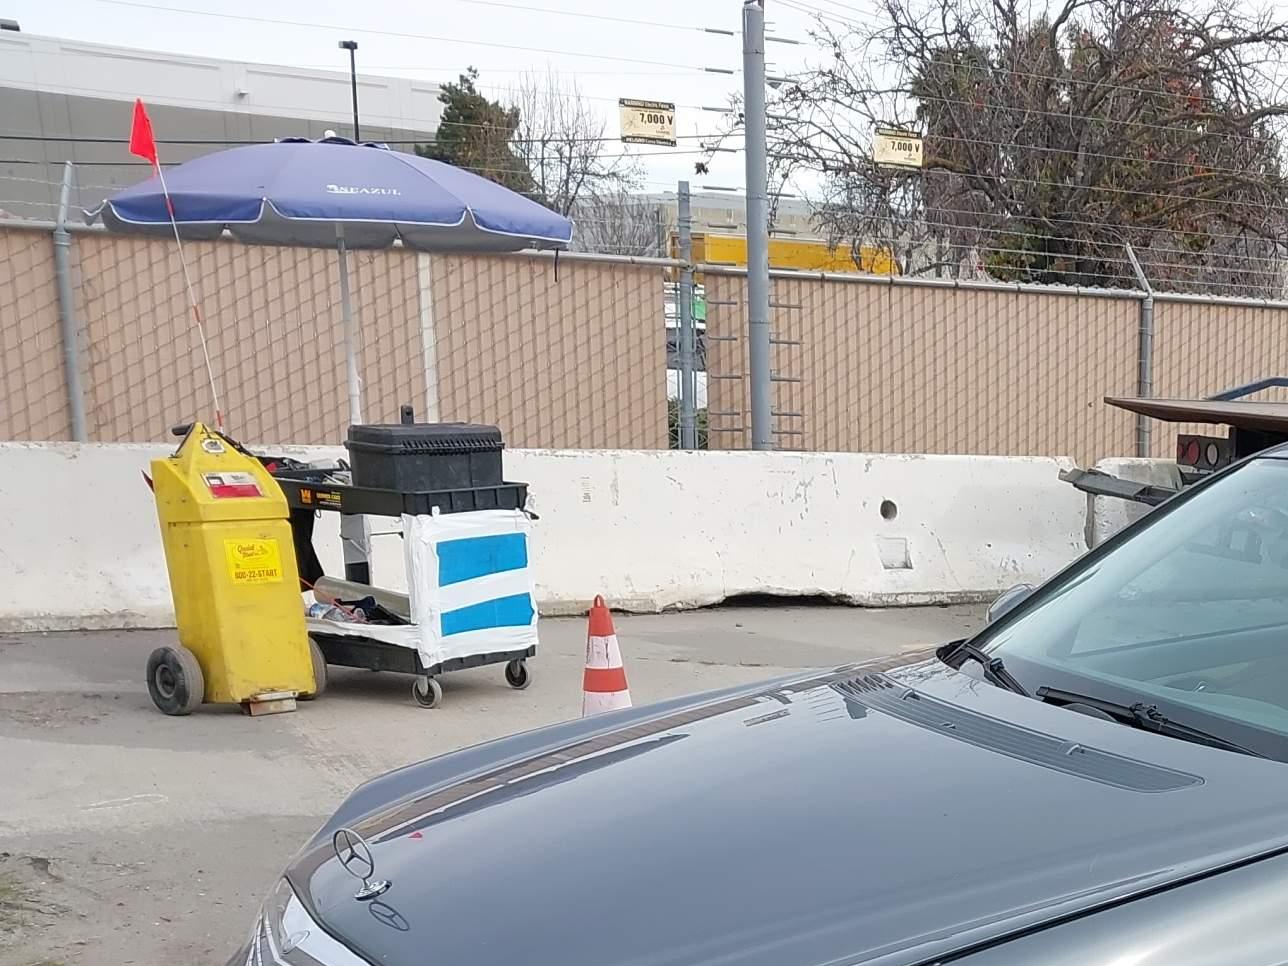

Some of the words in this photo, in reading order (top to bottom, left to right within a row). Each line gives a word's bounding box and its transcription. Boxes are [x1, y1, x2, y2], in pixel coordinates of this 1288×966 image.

[640, 113, 665, 125] 7,000
[667, 115, 673, 126] V
[891, 141, 913, 152] 7,000
[915, 143, 920, 153] V
